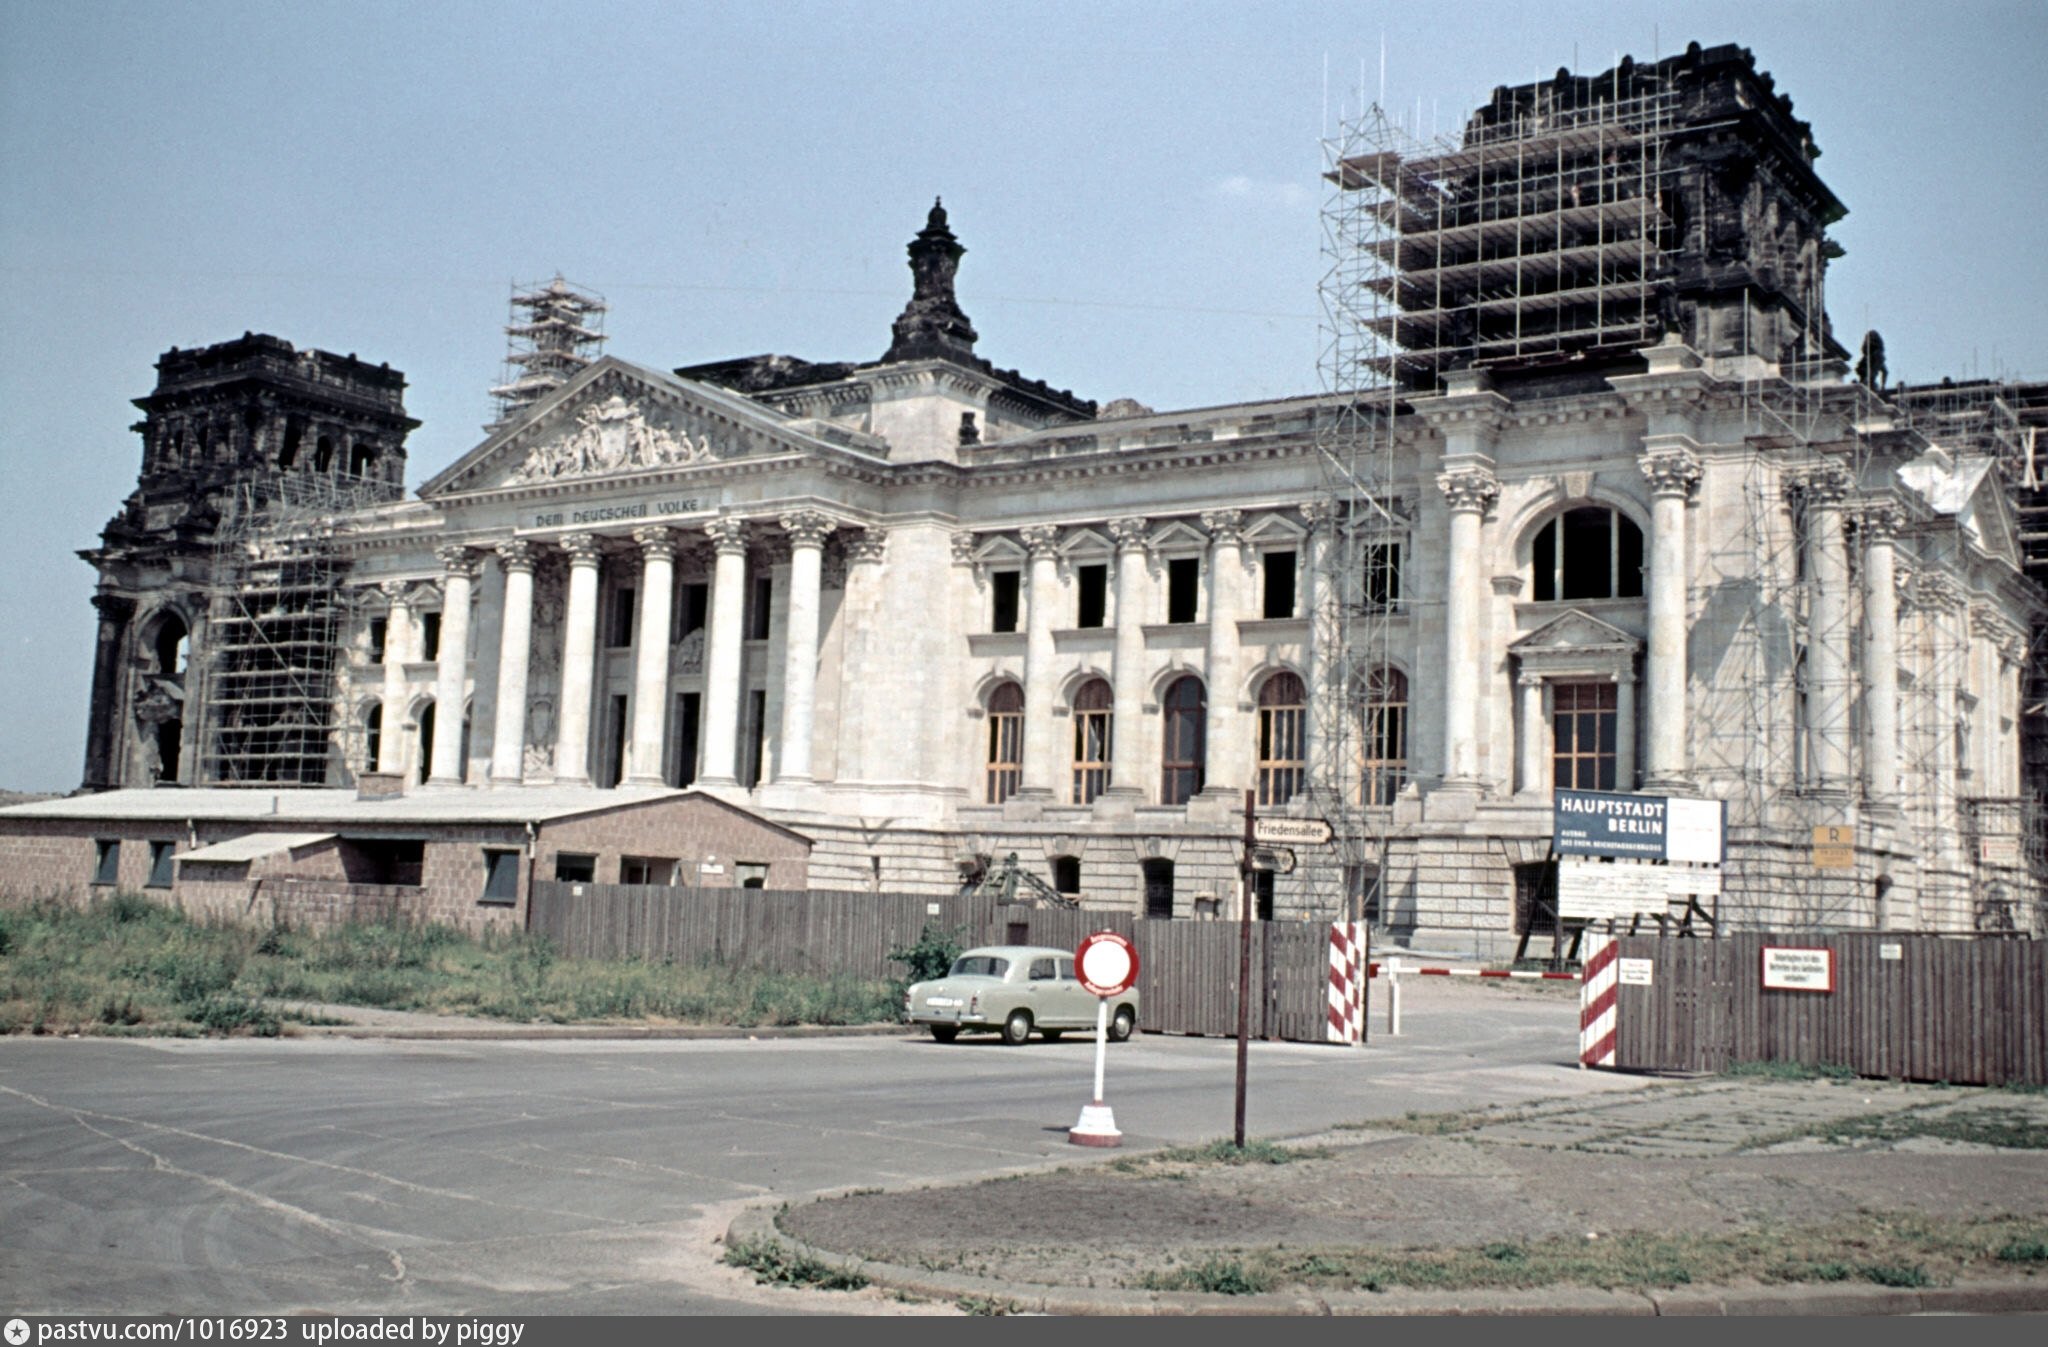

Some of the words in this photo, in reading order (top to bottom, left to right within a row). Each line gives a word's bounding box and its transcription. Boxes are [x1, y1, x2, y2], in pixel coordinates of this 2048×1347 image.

[535, 513, 563, 528] DEM
[573, 504, 647, 523] DEUTSCHEN
[658, 499, 698, 515] VOLKE
[1561, 797, 1664, 818] HAUPTSTADT
[1257, 821, 1324, 838] Friedensallee
[1608, 818, 1663, 835] BERLIN
